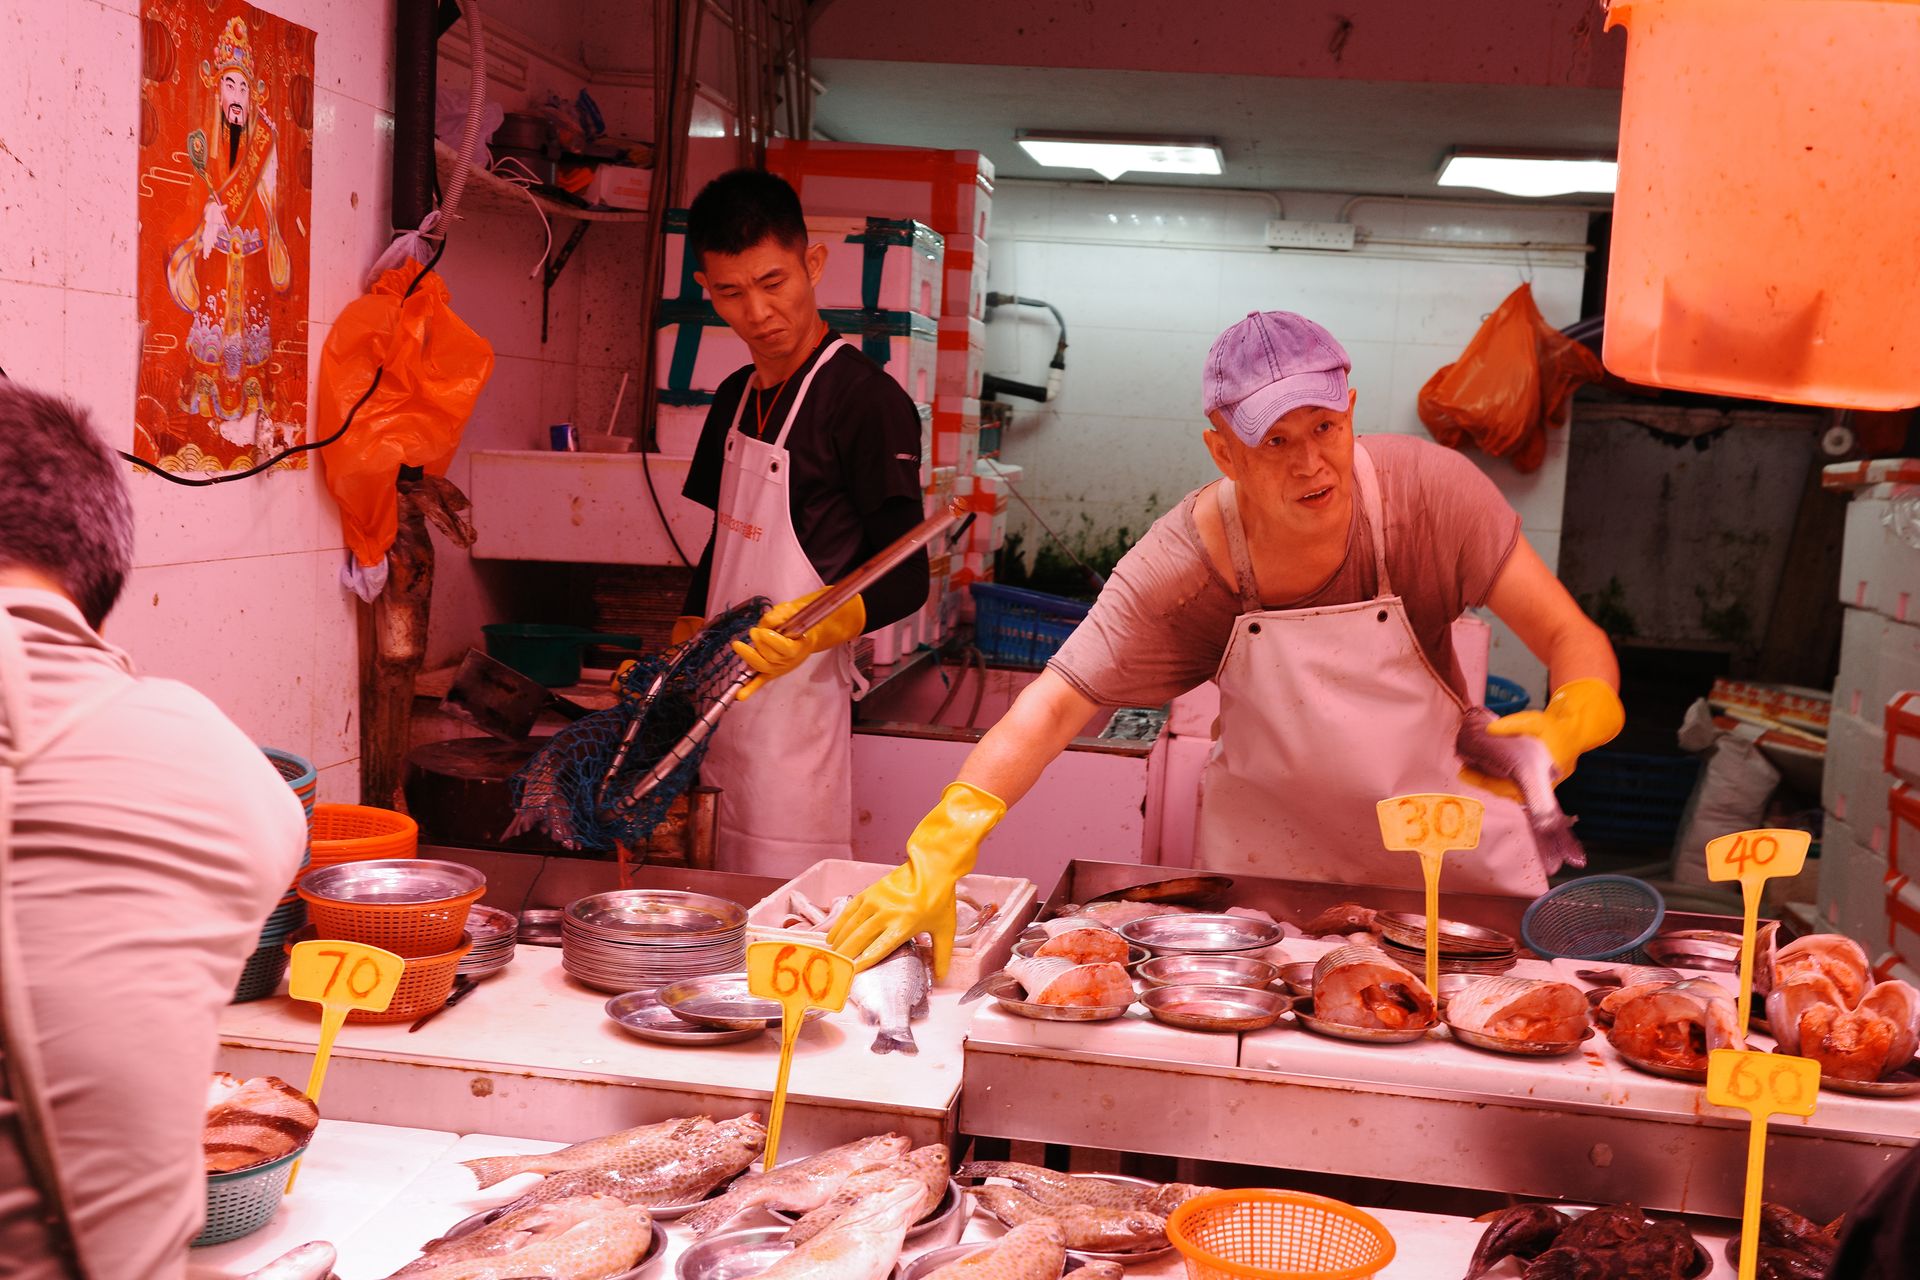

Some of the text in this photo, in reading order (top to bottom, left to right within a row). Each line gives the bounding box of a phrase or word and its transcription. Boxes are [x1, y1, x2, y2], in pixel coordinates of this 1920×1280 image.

[1397, 797, 1464, 844] 30
[1724, 834, 1779, 876] 40
[317, 950, 382, 998] 70
[771, 945, 834, 1002] 60
[1726, 1057, 1804, 1104] 60
